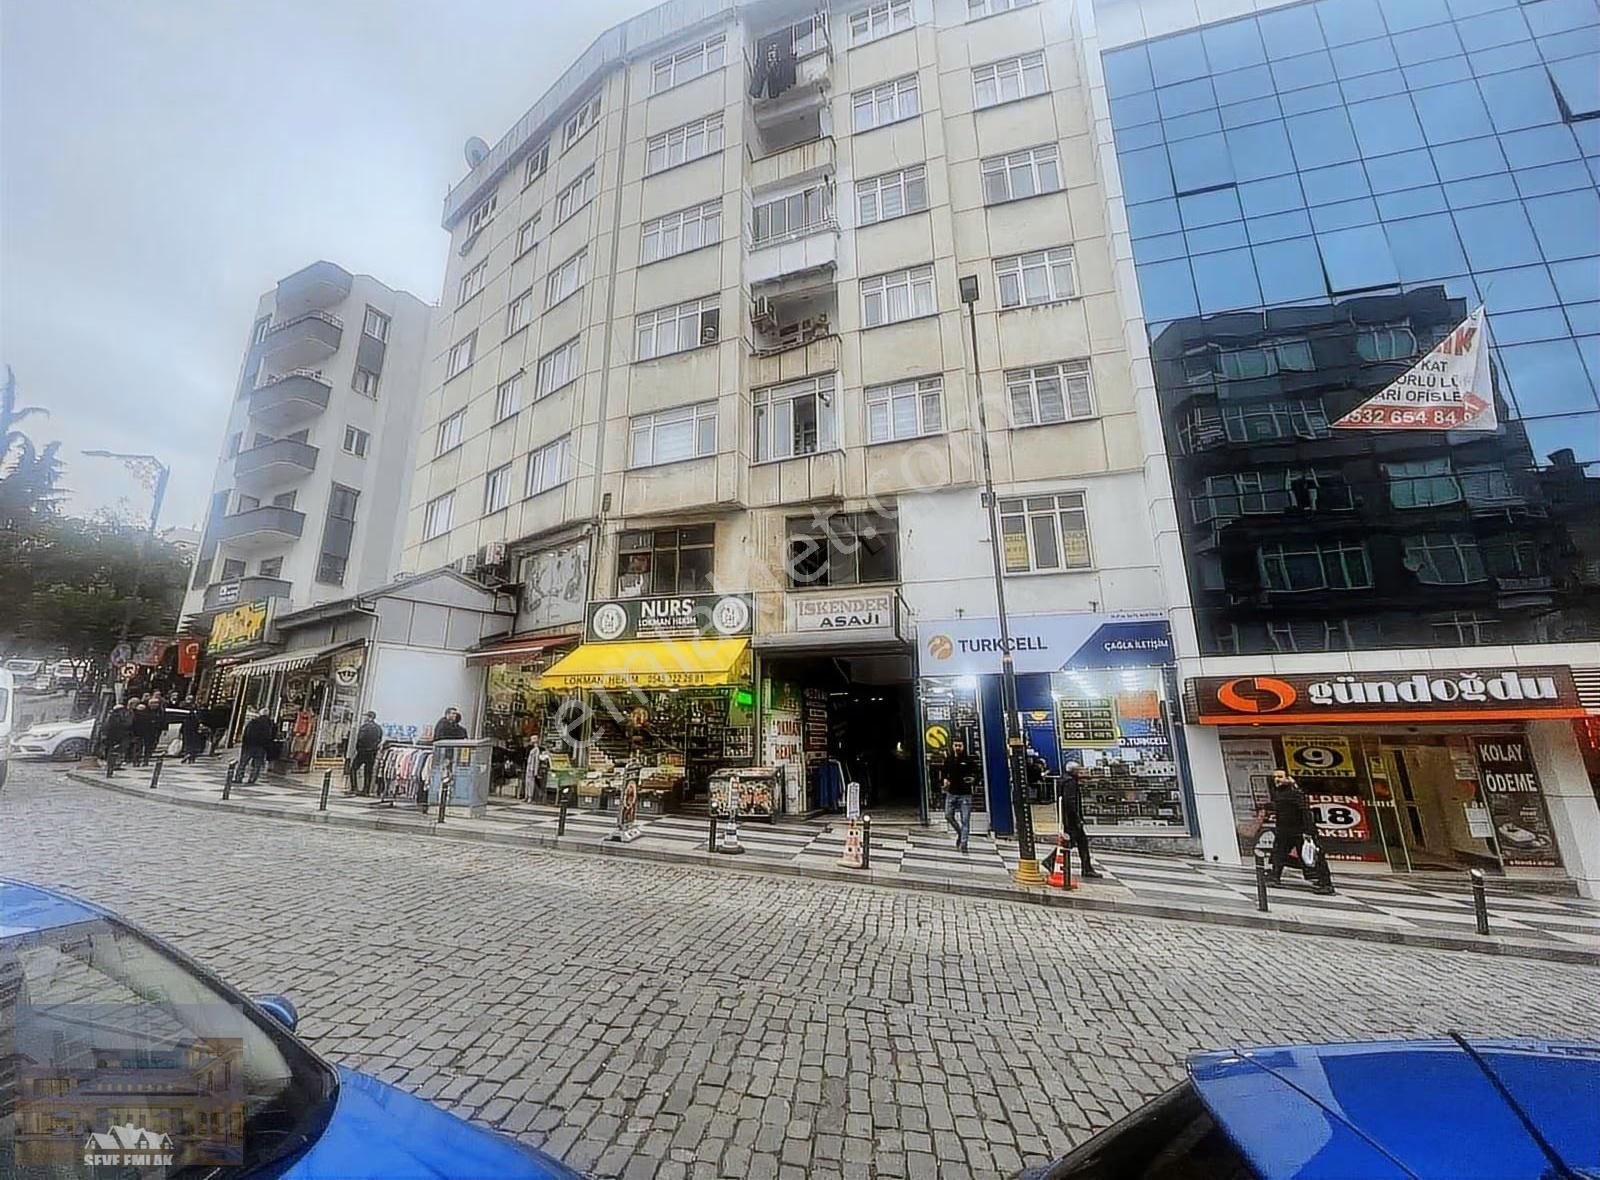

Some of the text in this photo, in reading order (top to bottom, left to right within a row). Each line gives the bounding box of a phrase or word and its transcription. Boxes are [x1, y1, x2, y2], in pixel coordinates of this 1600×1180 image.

[1421, 361, 1448, 372] KAT
[1390, 410, 1428, 424] 654
[1434, 410, 1457, 424] 84
[641, 599, 692, 618] NURS
[958, 636, 1048, 653] TURKCELL
[1307, 672, 1557, 704] gündoğdu
[1302, 748, 1334, 768] 9
[1480, 744, 1522, 761] KOLAY
[1485, 770, 1538, 792] ÖDEME
[1307, 794, 1359, 804] LDEN
[1313, 807, 1354, 825] 18
